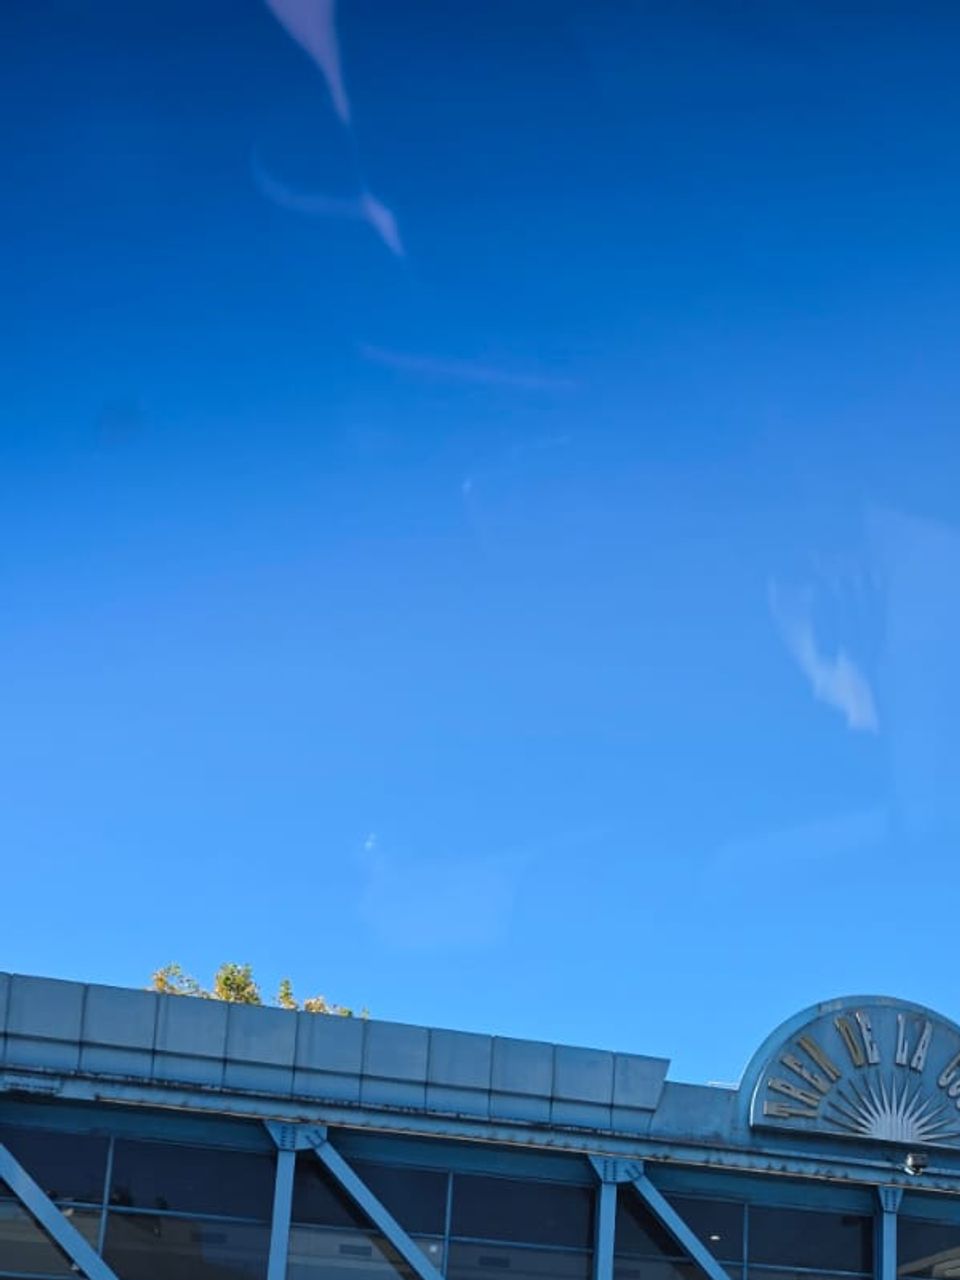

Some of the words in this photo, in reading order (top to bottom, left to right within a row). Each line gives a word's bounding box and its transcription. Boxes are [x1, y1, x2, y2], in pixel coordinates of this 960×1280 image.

[762, 1034, 842, 1118] TREN
[834, 1010, 880, 1067] DE
[896, 1013, 933, 1074] LA
